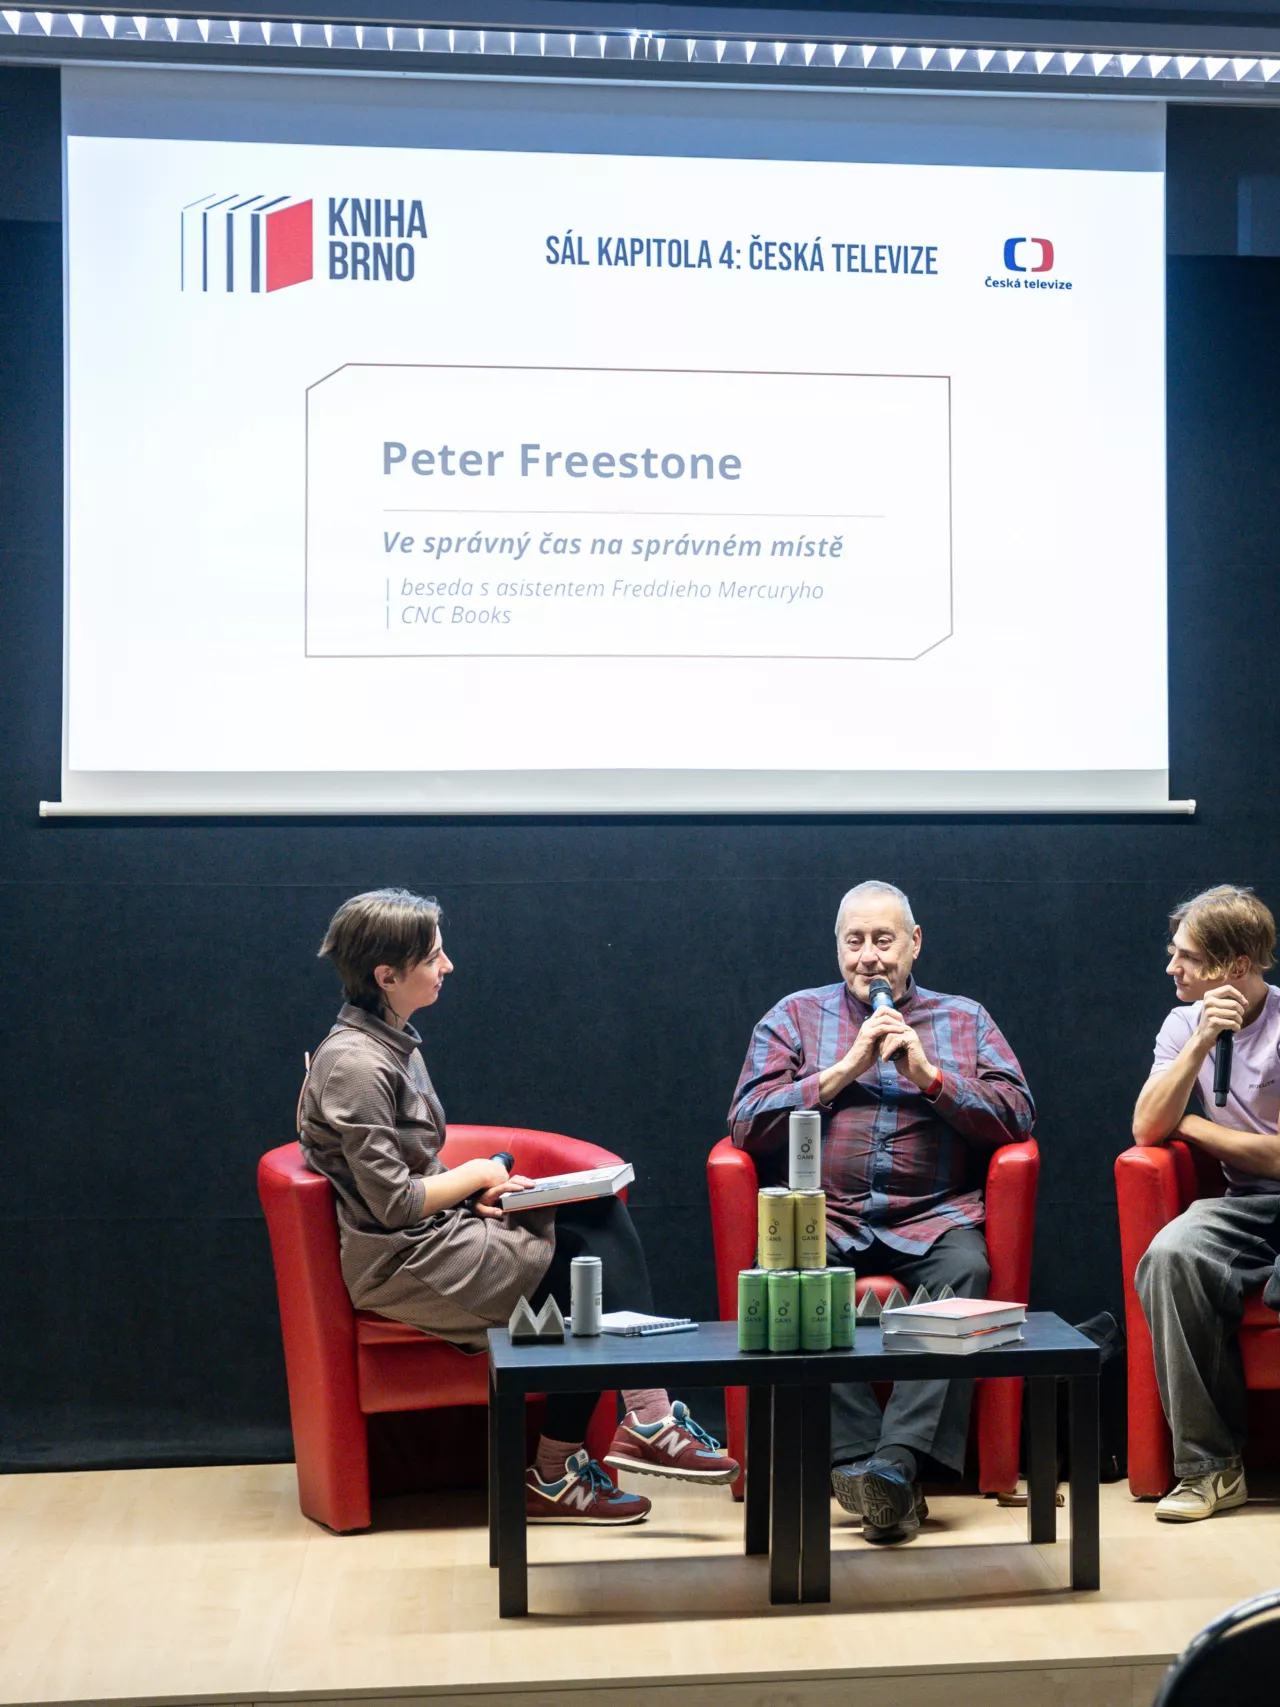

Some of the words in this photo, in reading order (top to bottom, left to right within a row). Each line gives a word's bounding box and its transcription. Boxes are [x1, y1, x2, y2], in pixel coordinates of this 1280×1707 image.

[328, 197, 428, 239] KNIHA
[328, 241, 416, 282] BRNO
[545, 229, 590, 265] SÁL
[597, 236, 711, 269] KAPITOLA
[718, 240, 742, 270] 4:
[748, 234, 825, 272] ČESKÁ
[831, 243, 939, 275] TELEVIZE
[984, 275, 1021, 289] Česká
[1023, 279, 1073, 290] televize
[382, 441, 505, 477] Peter
[520, 443, 743, 481] Freestone
[383, 531, 415, 554] Ve
[422, 530, 532, 561] správný
[538, 531, 582, 555] čas
[589, 537, 622, 555] na
[630, 532, 762, 562] správném
[770, 534, 844, 558] místě
[400, 577, 474, 598] beseda
[479, 582, 490, 597] s
[496, 578, 605, 599] asistentem
[612, 579, 712, 600] Freddieho
[718, 580, 825, 604] Mercuryho
[401, 605, 446, 625] CNC
[450, 605, 512, 625] Books
